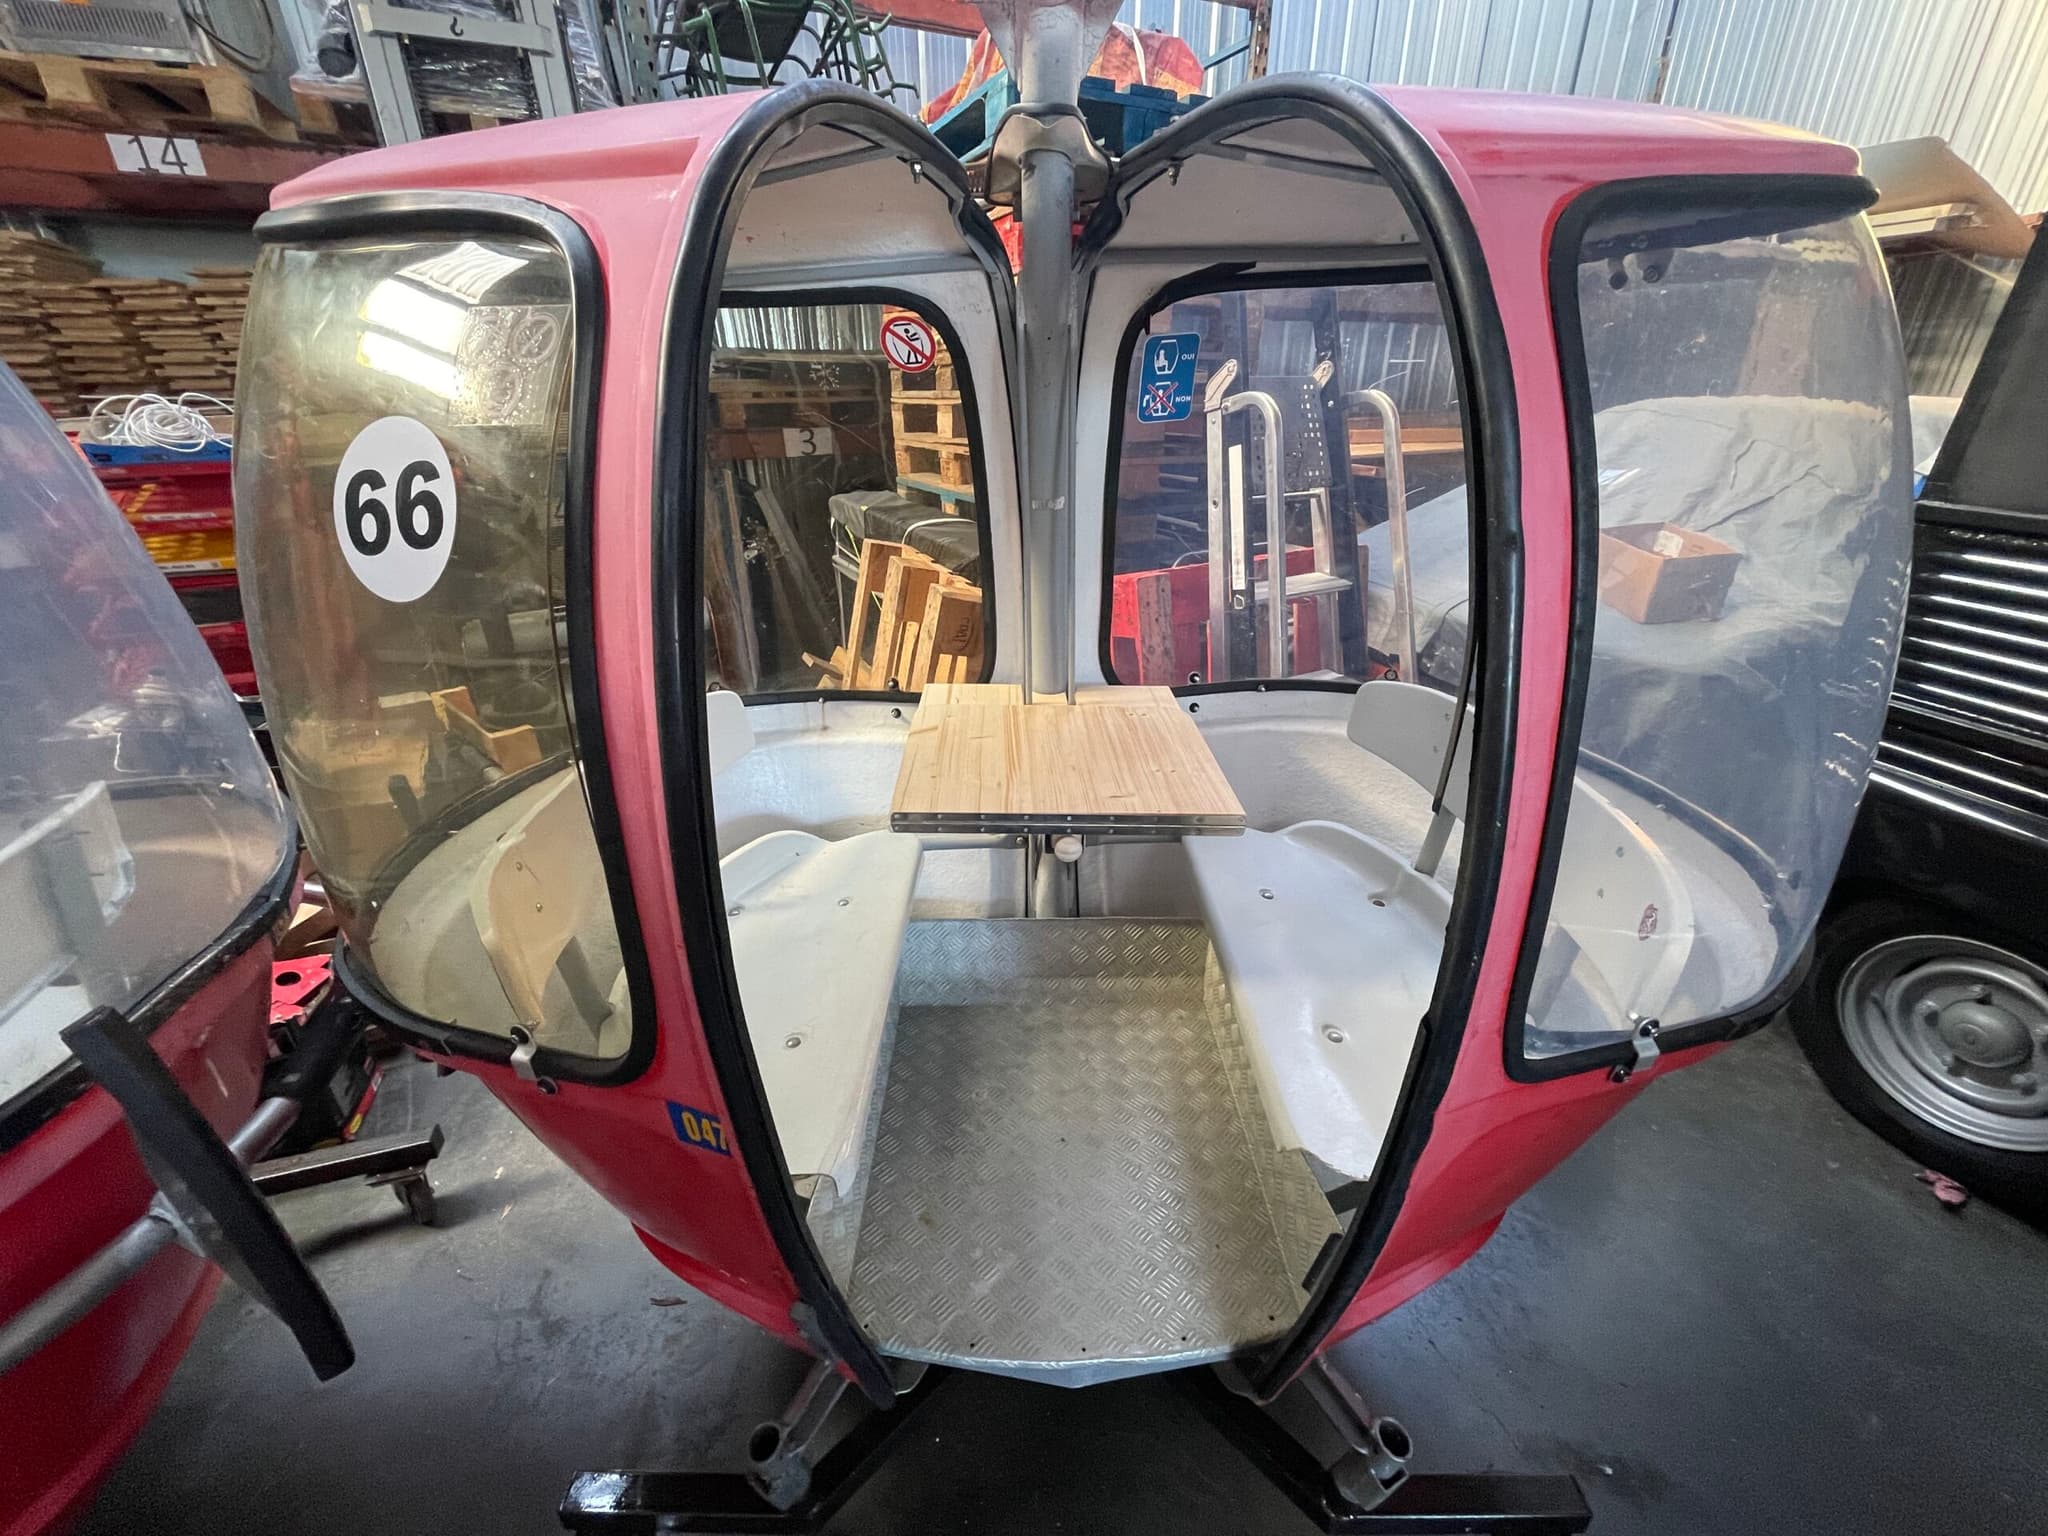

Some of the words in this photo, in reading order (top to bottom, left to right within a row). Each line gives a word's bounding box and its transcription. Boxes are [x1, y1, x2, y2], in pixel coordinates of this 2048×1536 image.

[128, 136, 188, 176] 14
[1181, 353, 1195, 361] OUI
[1175, 395, 1191, 403] NON
[800, 429, 816, 456] 3
[345, 460, 444, 556] 66
[681, 1111, 728, 1150] 047
